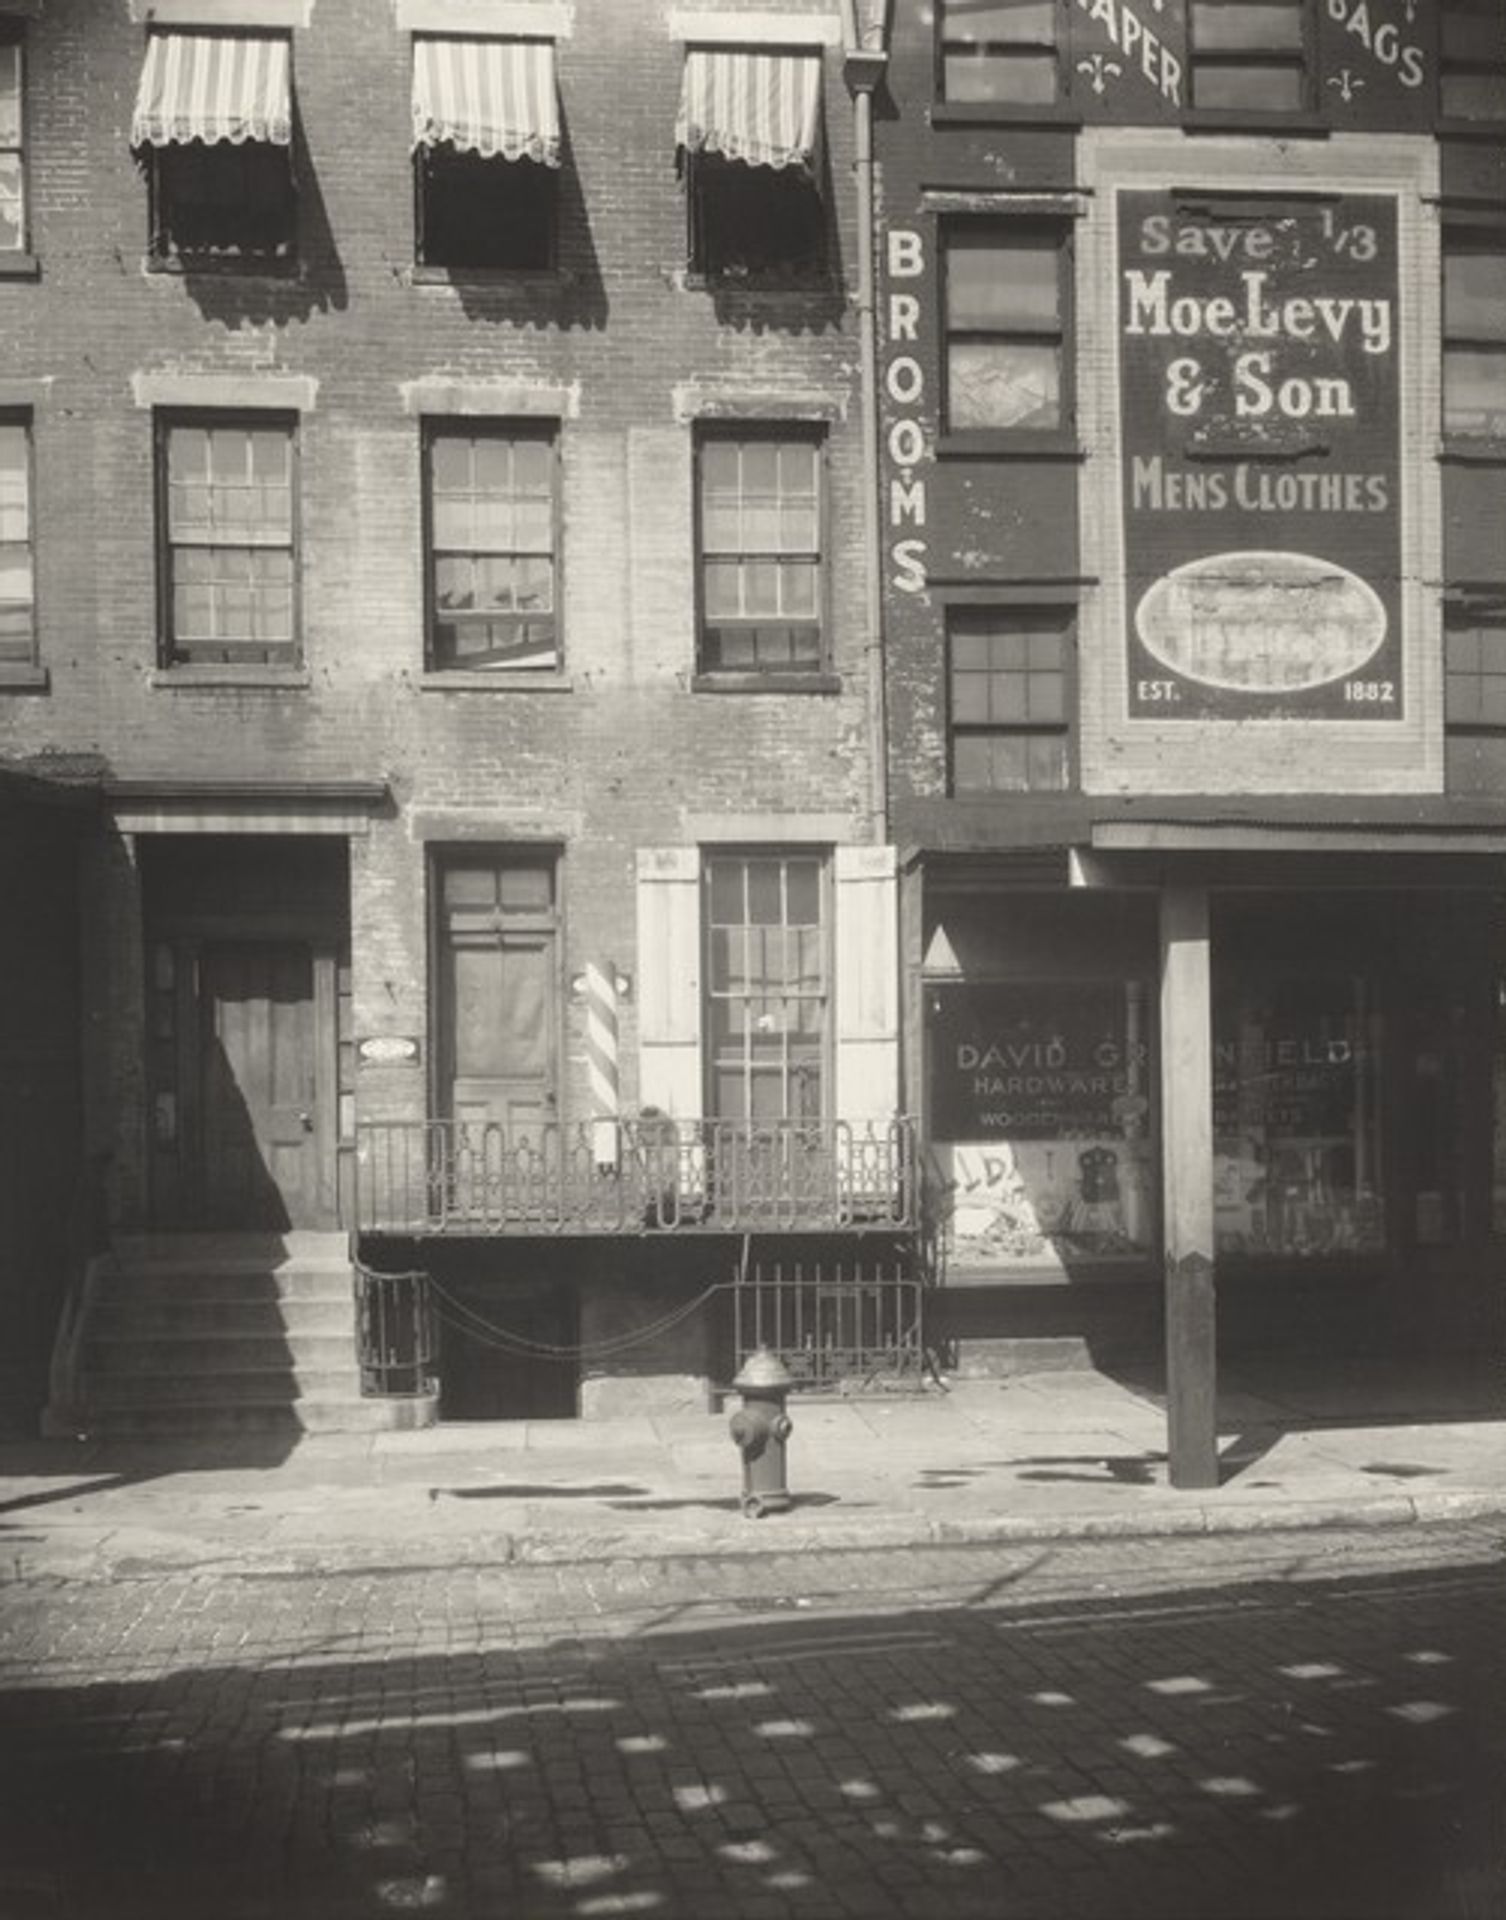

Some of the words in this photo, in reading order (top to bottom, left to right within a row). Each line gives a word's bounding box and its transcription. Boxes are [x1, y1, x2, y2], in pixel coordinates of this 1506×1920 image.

[1078, 0, 1181, 107] APER
[1140, 215, 1273, 261] Save
[1321, 209, 1377, 261] 1/3
[1166, 357, 1204, 416] &
[1235, 352, 1355, 417] Son
[887, 230, 927, 592] BROOMS
[1132, 455, 1228, 510] MENS
[1234, 464, 1388, 512] CLOTHES
[1137, 680, 1181, 701] EST.
[1344, 681, 1395, 701] 1882
[956, 1042, 1066, 1070] DAVID
[973, 1075, 1128, 1095] HARDWARE
